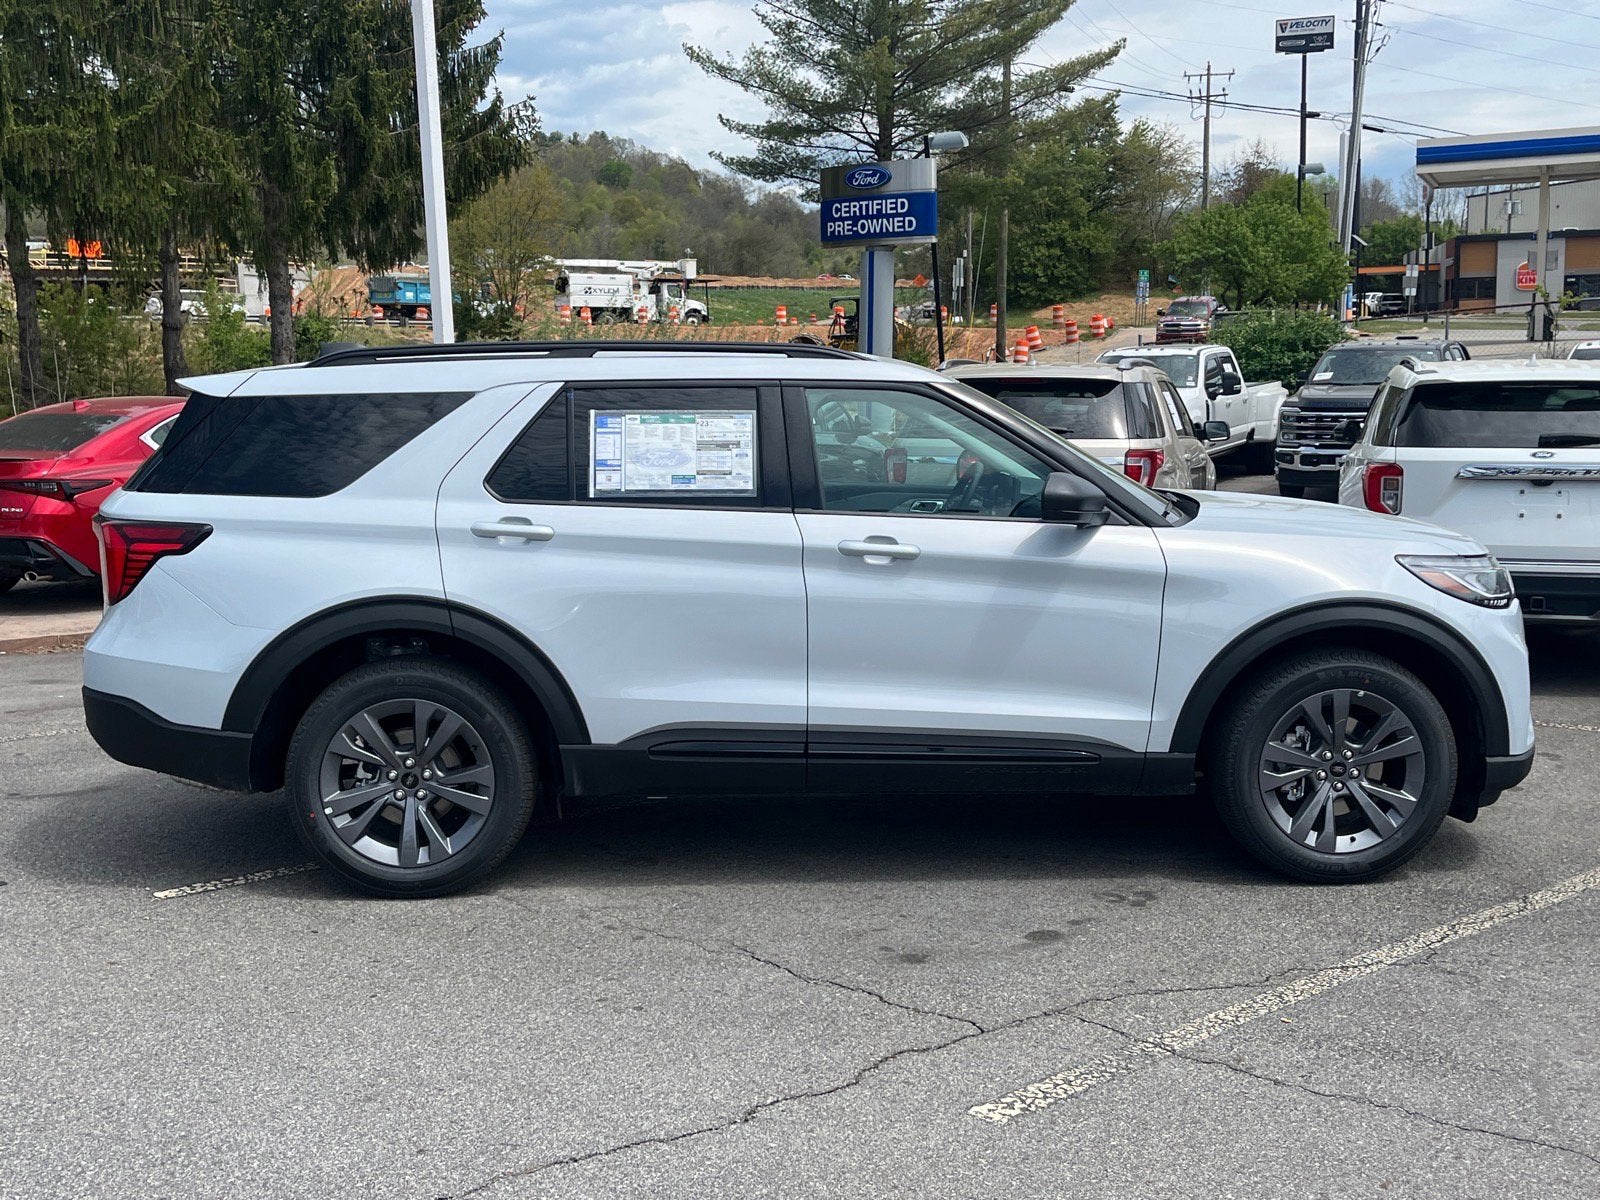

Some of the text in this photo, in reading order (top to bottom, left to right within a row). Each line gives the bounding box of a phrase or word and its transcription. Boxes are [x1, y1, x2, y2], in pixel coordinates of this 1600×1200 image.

[1289, 19, 1331, 29] VELOCITY
[852, 171, 880, 186] Ford
[832, 198, 909, 218] CERTIFIED
[827, 216, 917, 237] PRE-OWNED
[1518, 276, 1536, 284] KIN
[643, 452, 680, 467] Ford
